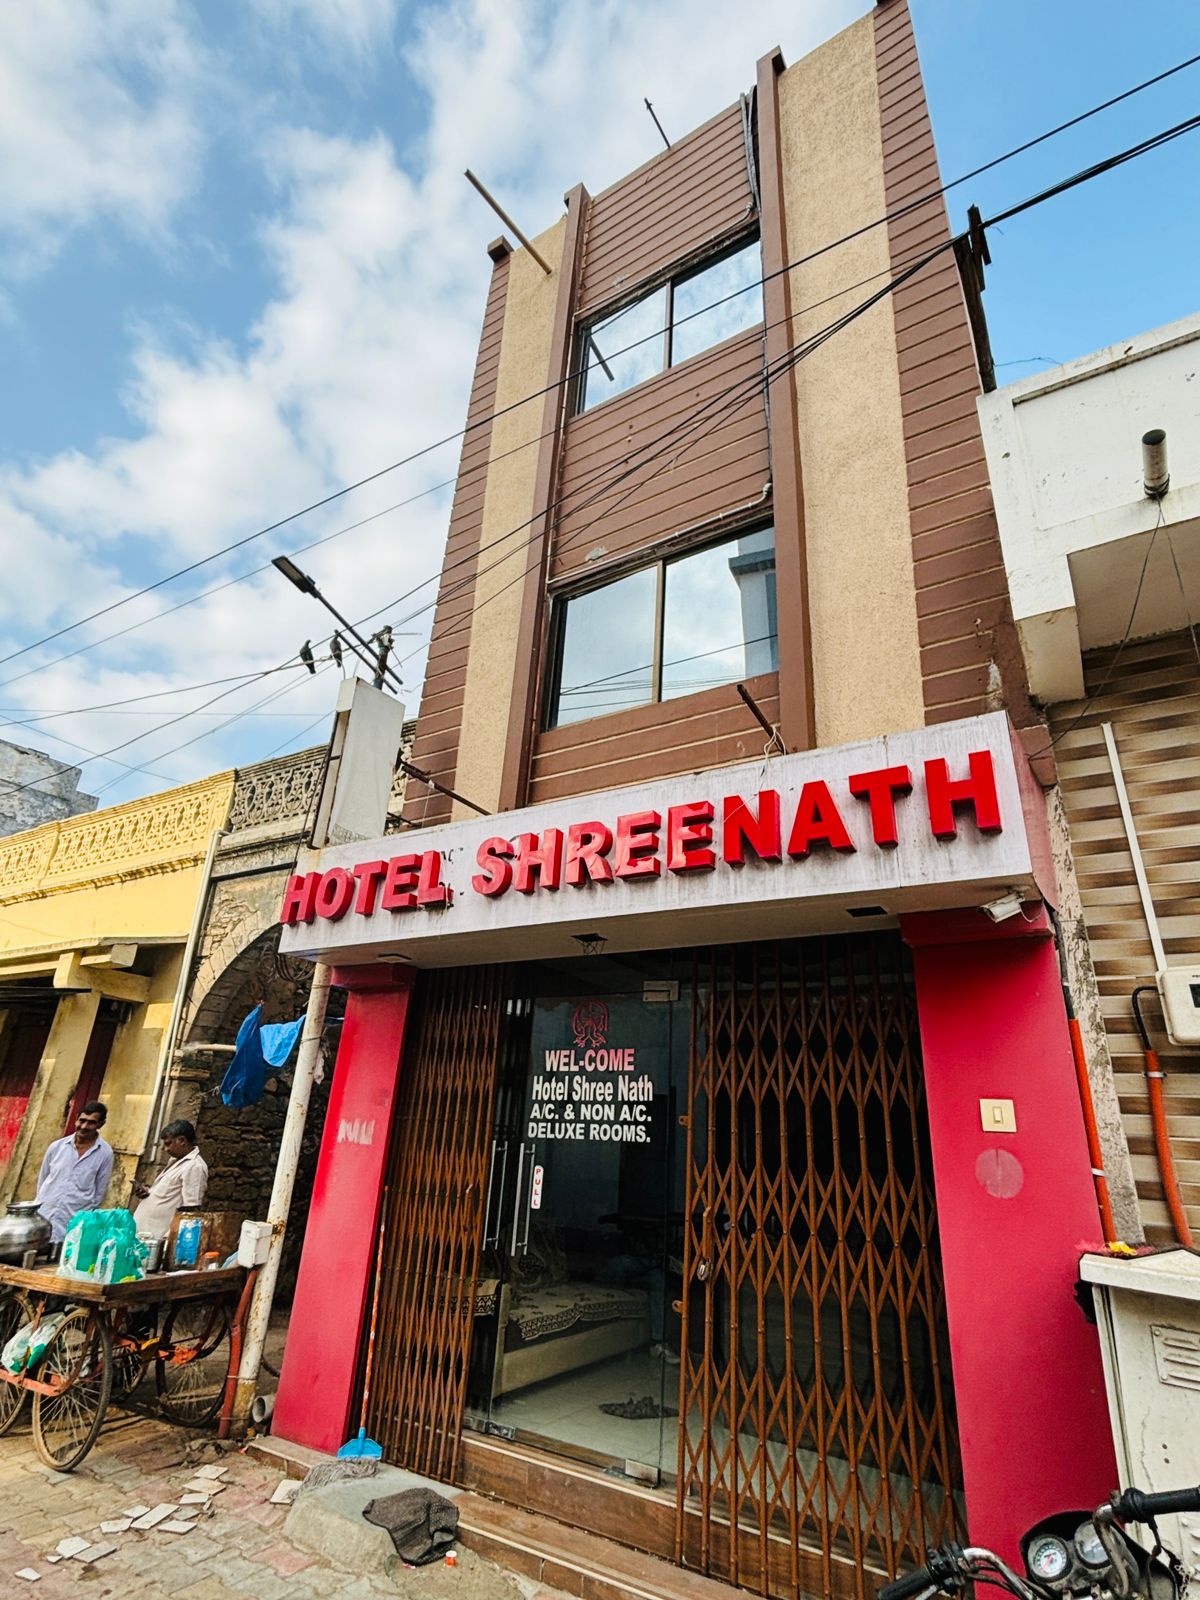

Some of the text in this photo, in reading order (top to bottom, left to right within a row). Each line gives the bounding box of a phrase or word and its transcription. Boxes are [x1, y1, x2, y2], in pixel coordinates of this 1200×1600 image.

[280, 750, 1002, 925] HOTEL SHREENATH
[545, 1048, 635, 1072] WEL-COME
[532, 1074, 654, 1101] Hotel Shree Nath
[530, 1104, 652, 1122] A/C. & NON A/C.
[528, 1122, 651, 1143] DELUXE ROOMS.
[533, 1168, 542, 1206] PULL
